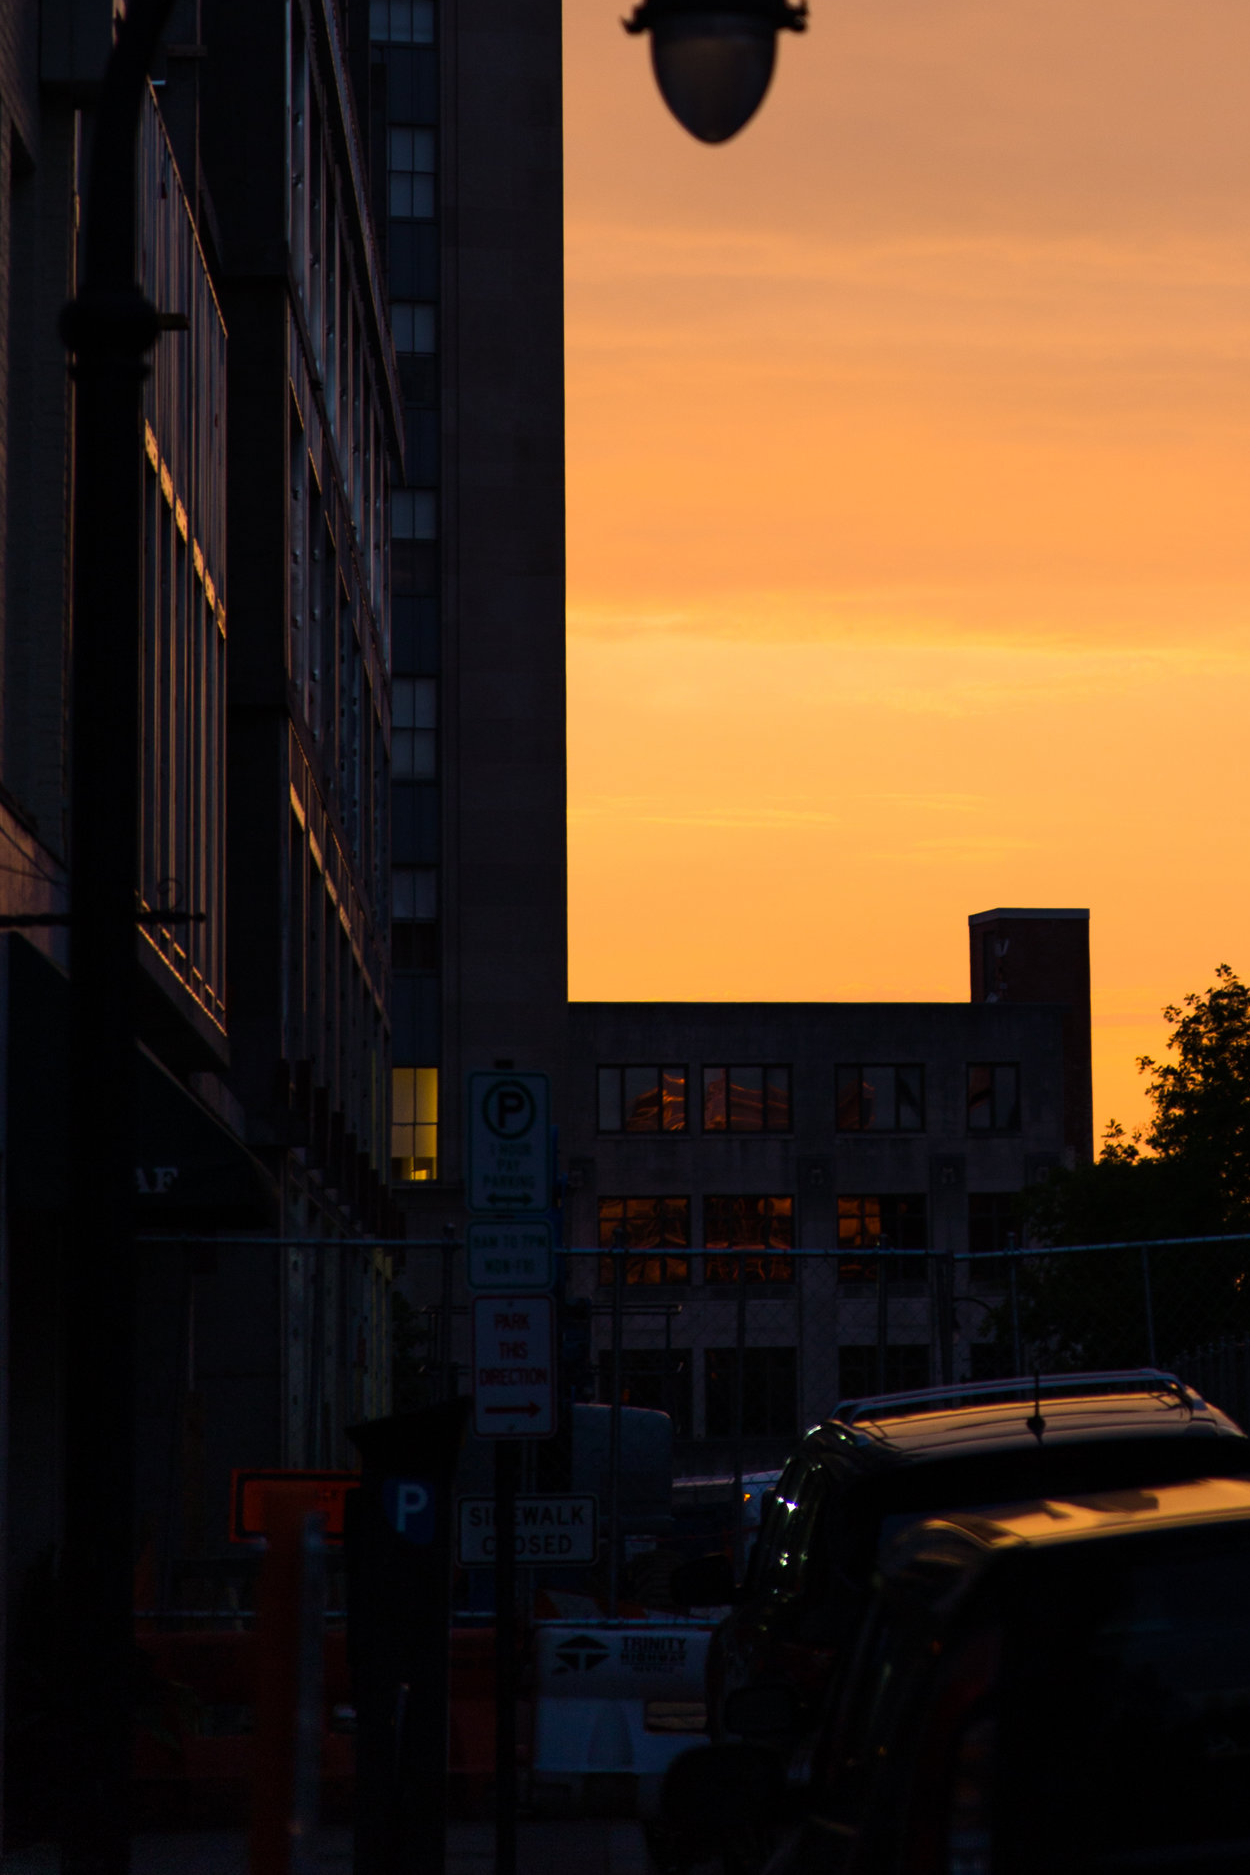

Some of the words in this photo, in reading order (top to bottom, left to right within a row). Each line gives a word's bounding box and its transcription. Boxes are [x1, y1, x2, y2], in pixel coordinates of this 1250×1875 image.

[497, 1091, 524, 1128] P
[483, 1175, 535, 1189] PARKING
[493, 1314, 530, 1330] PARK
[498, 1342, 528, 1359] THIS
[479, 1368, 547, 1386] DIRECTION
[395, 1483, 428, 1533] P
[469, 1506, 584, 1526] SIEWALK
[482, 1534, 572, 1555] COSED
[622, 1636, 686, 1651] TRINITY
